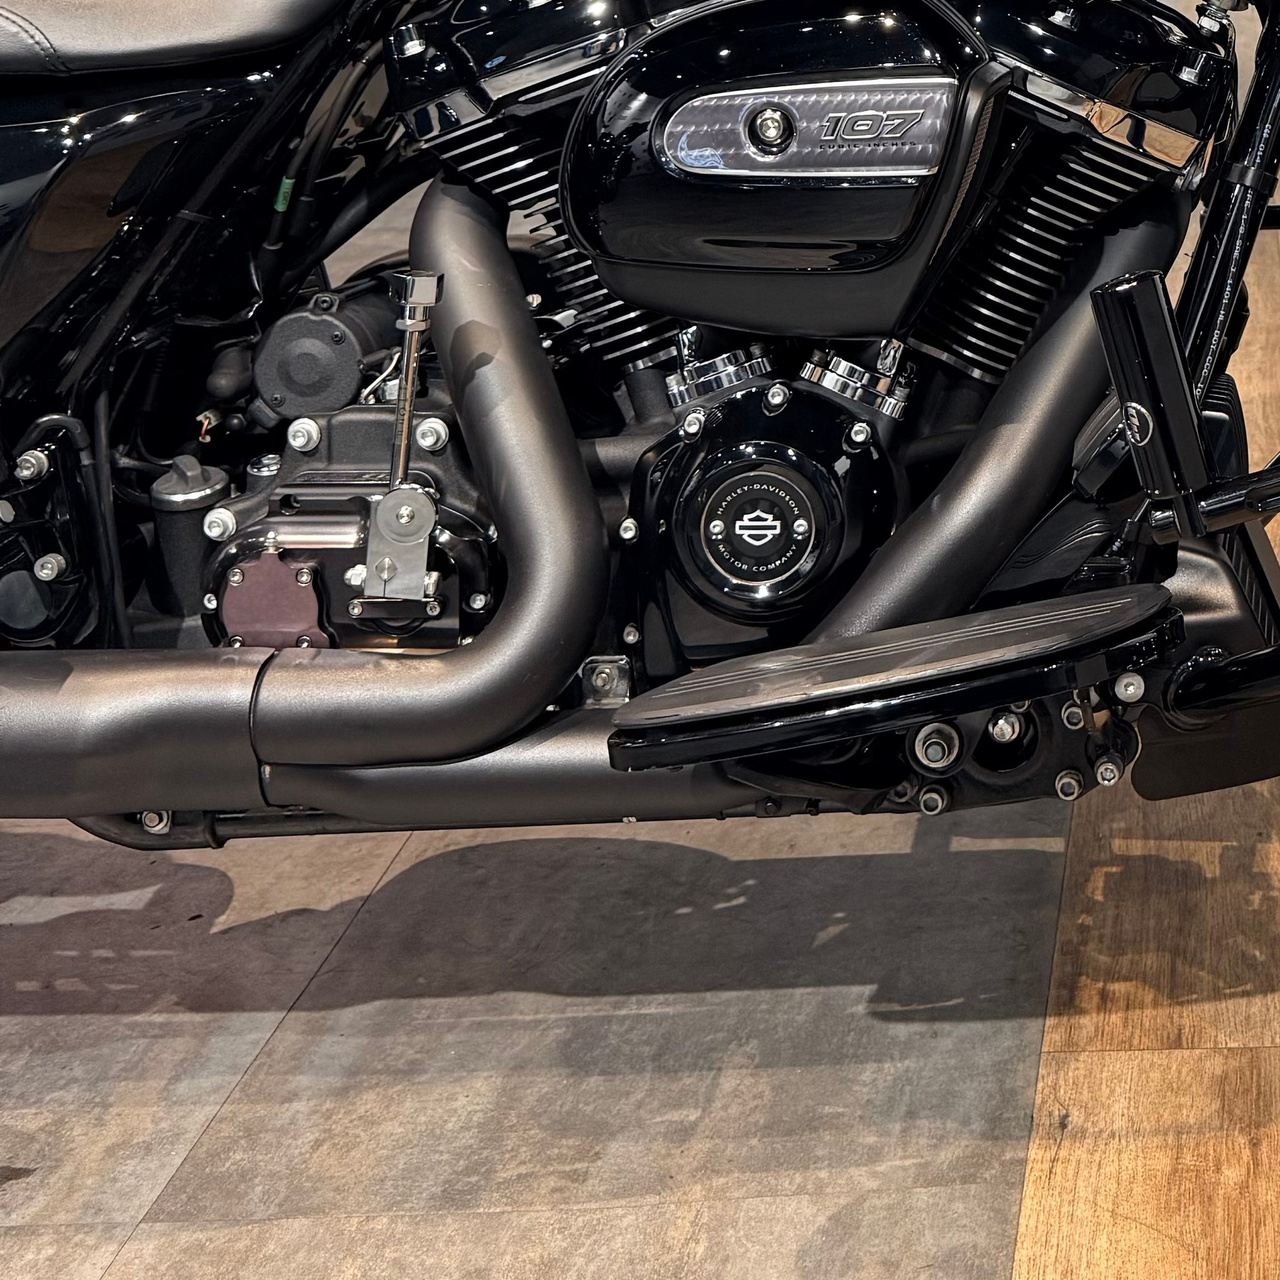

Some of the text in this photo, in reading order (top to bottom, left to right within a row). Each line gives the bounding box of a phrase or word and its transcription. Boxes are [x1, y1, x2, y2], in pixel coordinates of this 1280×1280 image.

[820, 110, 925, 140] 107
[717, 483, 800, 515] HARLEY-DAVIDSON
[718, 544, 797, 572] MOTOR COMPANY
